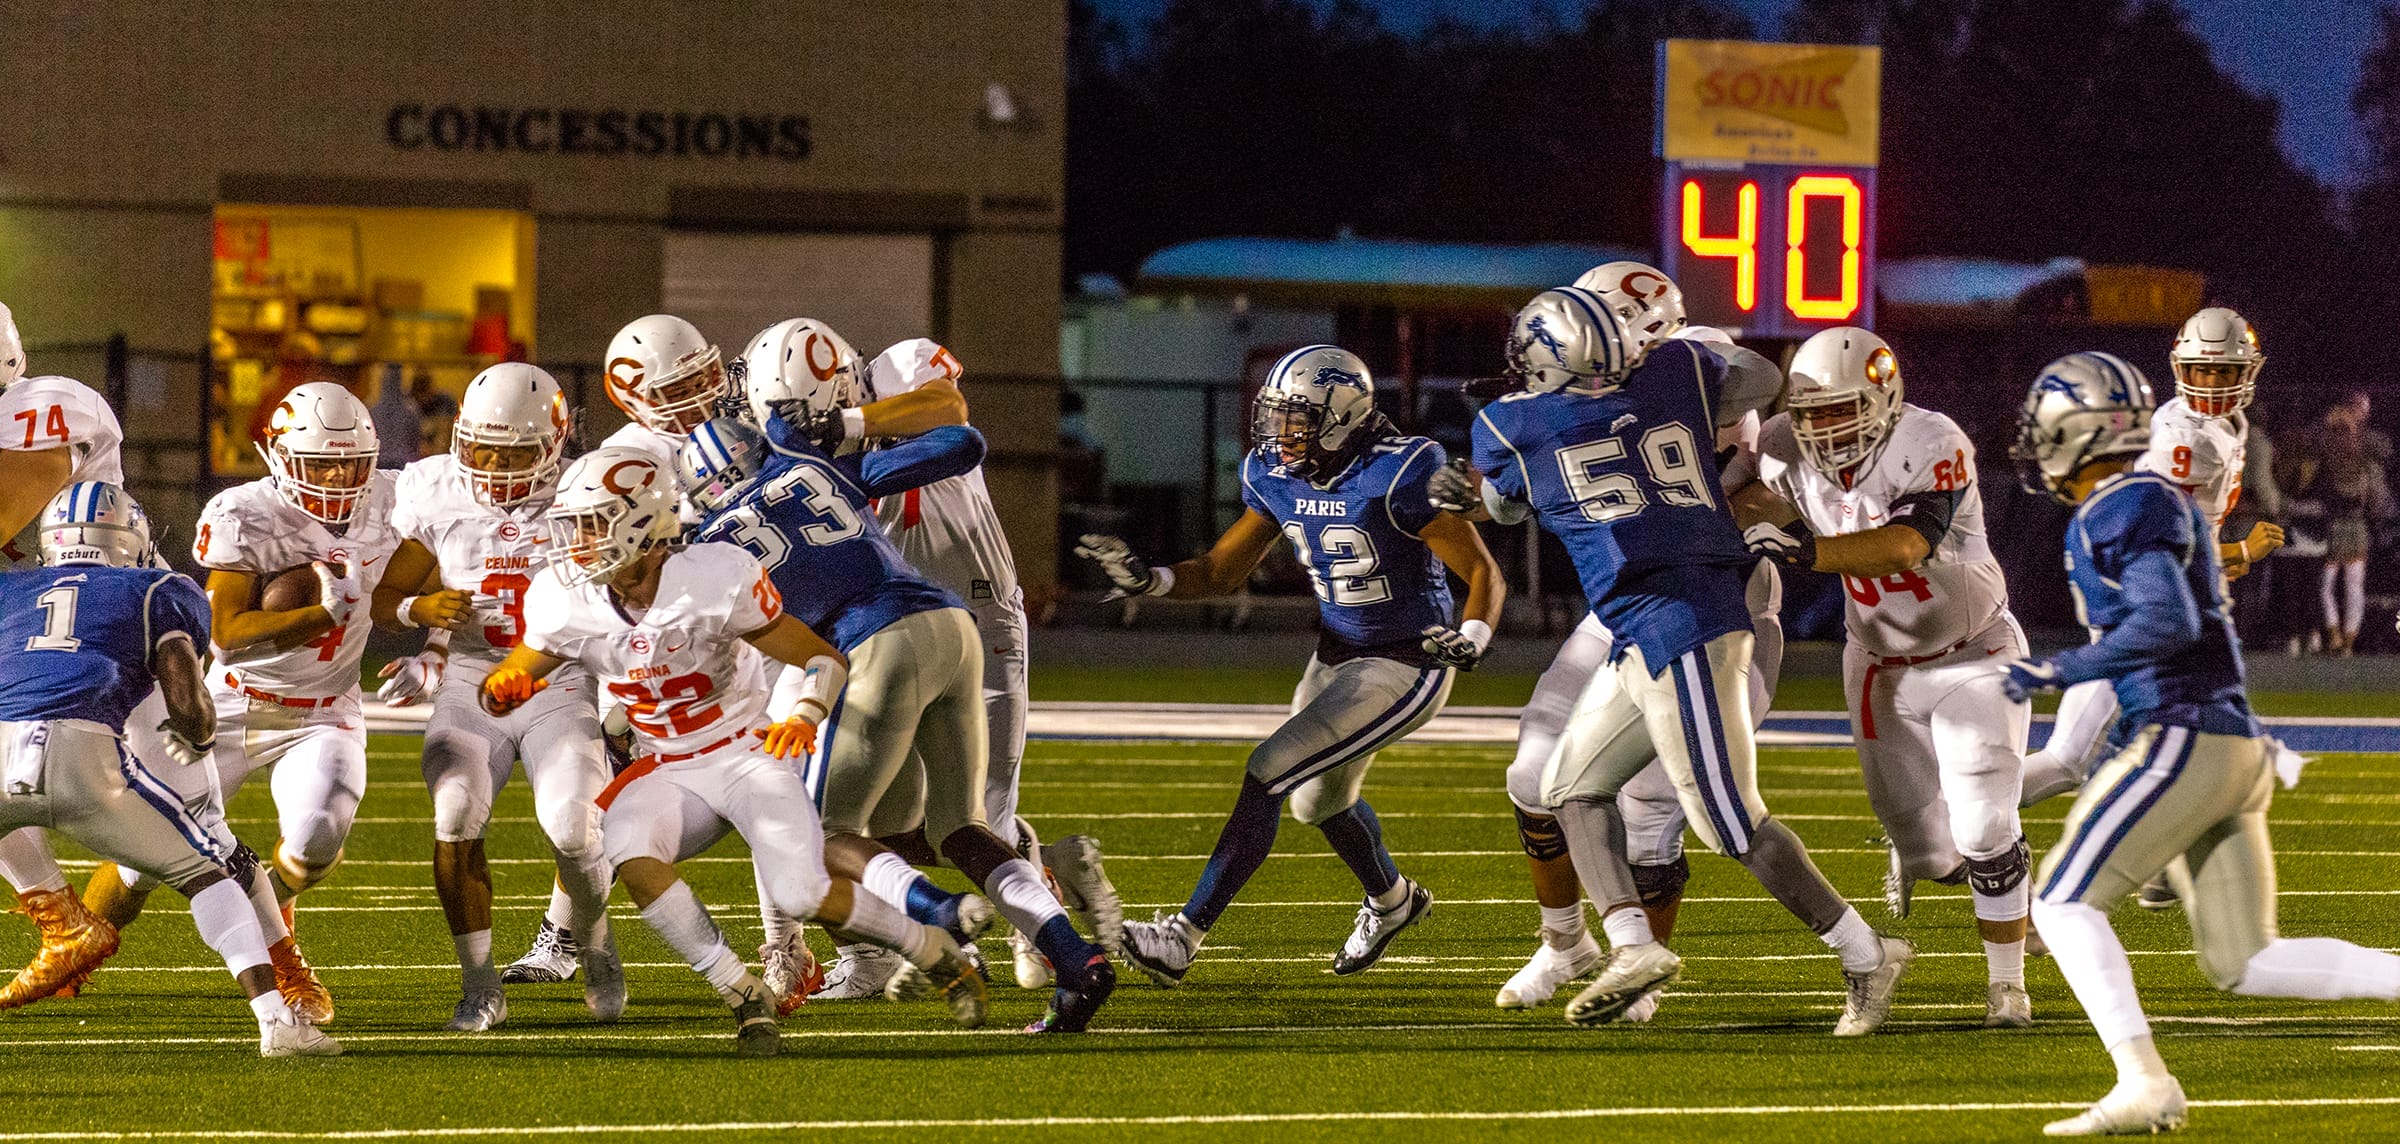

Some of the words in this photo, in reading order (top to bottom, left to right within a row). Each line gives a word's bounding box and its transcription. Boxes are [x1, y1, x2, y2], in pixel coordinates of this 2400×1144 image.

[1702, 69, 1844, 111] SONIC
[386, 103, 812, 160] CONCESSIONS
[1682, 176, 1861, 320] 40
[15, 404, 70, 448] 74
[718, 466, 744, 489] 33
[1555, 421, 1717, 523] 59
[1933, 448, 1968, 492] 64
[2171, 445, 2192, 478] 9
[701, 464, 866, 573] 33
[1294, 498, 1346, 517] PARIS
[197, 523, 211, 561] 4
[484, 556, 529, 569] CELINA
[1283, 520, 1393, 606] 12
[25, 586, 82, 653] 1
[481, 573, 531, 648] 3
[627, 664, 672, 680] CELINA
[607, 671, 724, 738] 22
